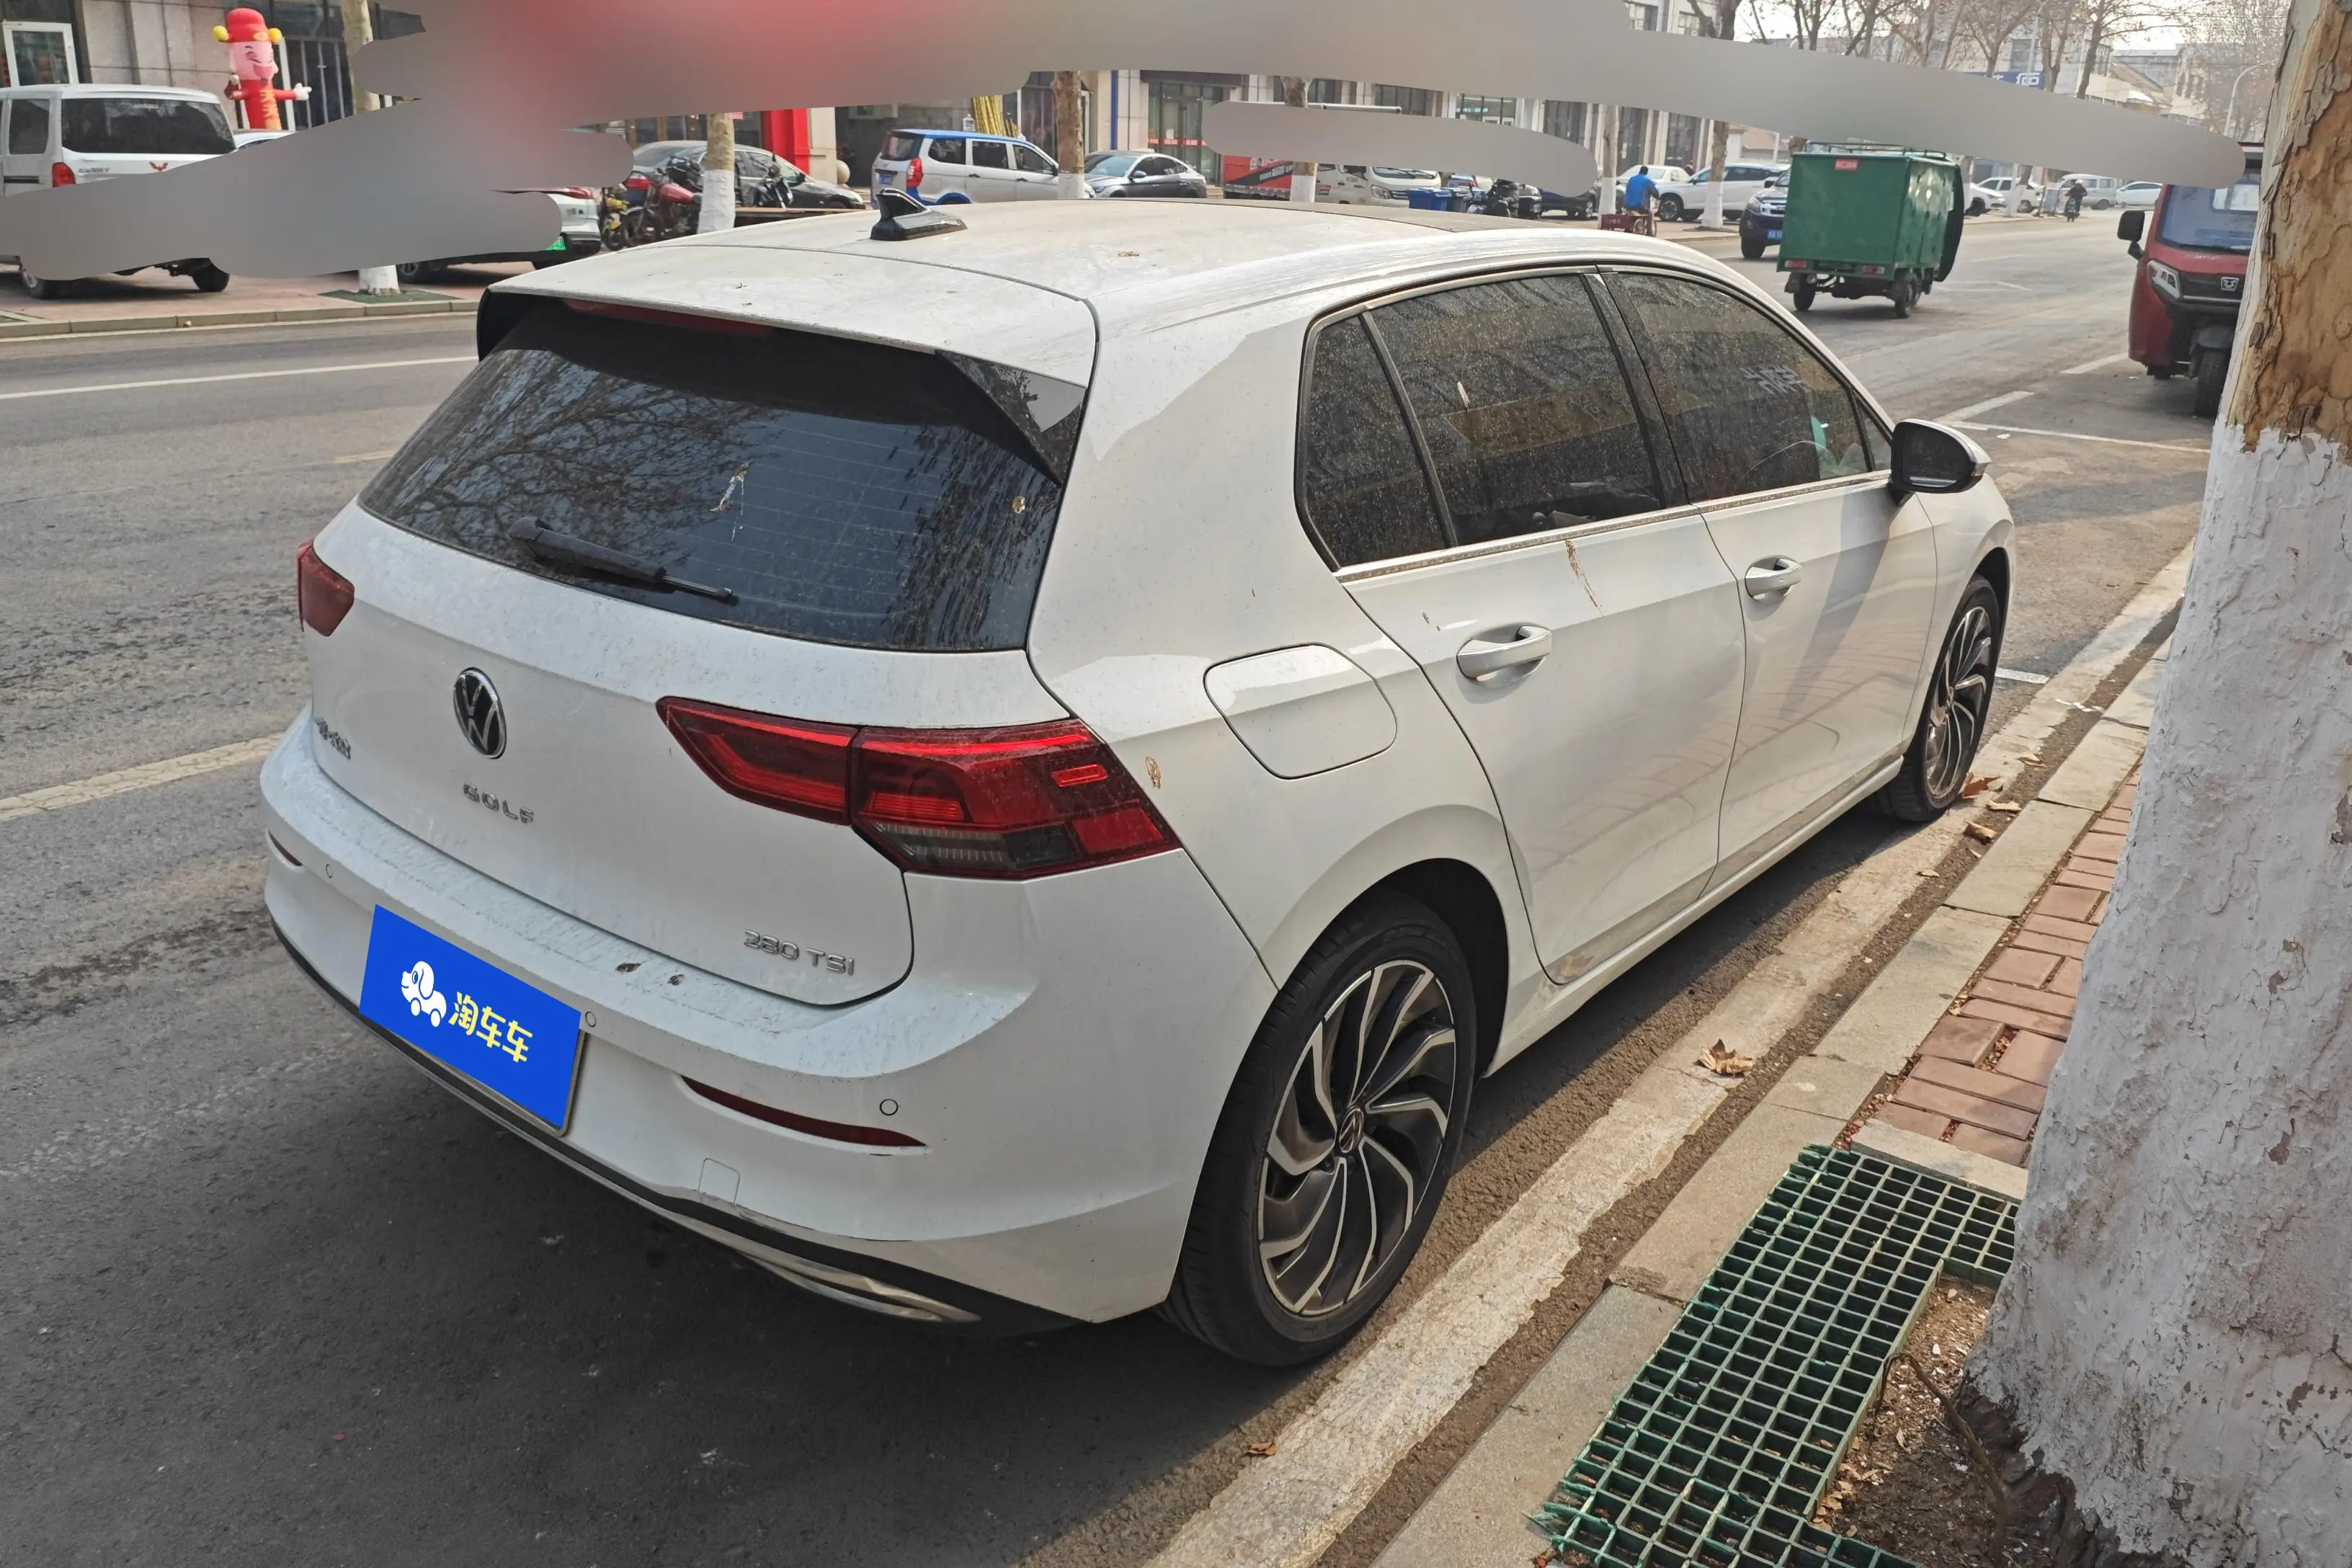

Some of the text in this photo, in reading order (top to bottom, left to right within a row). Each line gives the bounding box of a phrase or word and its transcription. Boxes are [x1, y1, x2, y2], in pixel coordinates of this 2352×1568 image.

[463, 783, 534, 824] GOLF
[743, 930, 855, 976] 280 TSI
